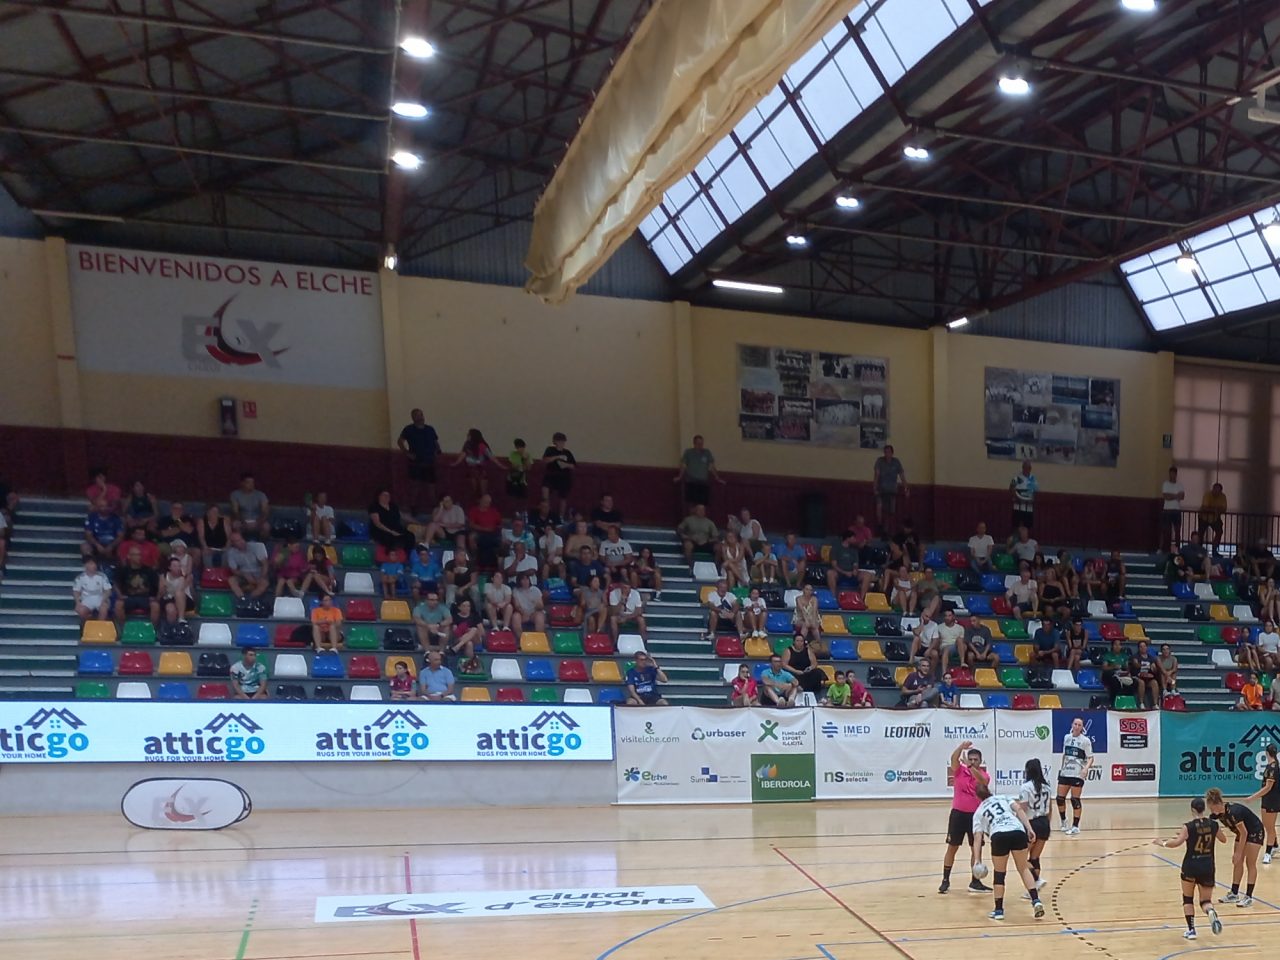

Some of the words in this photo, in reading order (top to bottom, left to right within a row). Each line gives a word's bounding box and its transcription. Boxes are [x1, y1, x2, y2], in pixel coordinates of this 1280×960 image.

[79, 251, 261, 286] BIENVENIDOS
[270, 270, 288, 288] A
[297, 271, 373, 296] ELCHE
[844, 725, 871, 734] IMED
[884, 726, 931, 738] LEOTRON
[944, 726, 978, 734] ILITIA
[1121, 721, 1146, 732] SDS
[706, 730, 747, 738] urbaser
[998, 728, 1035, 738] Domus
[316, 725, 429, 757] atticgo
[476, 726, 582, 757] atticgo
[621, 735, 680, 743] visitelche.com
[143, 729, 265, 761] atticgo
[641, 770, 668, 781] elche
[824, 771, 844, 782] ns
[761, 780, 811, 788] IBERDROLA
[1033, 791, 1049, 810] 27
[983, 802, 1005, 824] 33
[1194, 833, 1212, 854] 42
[528, 890, 646, 901] ciutat
